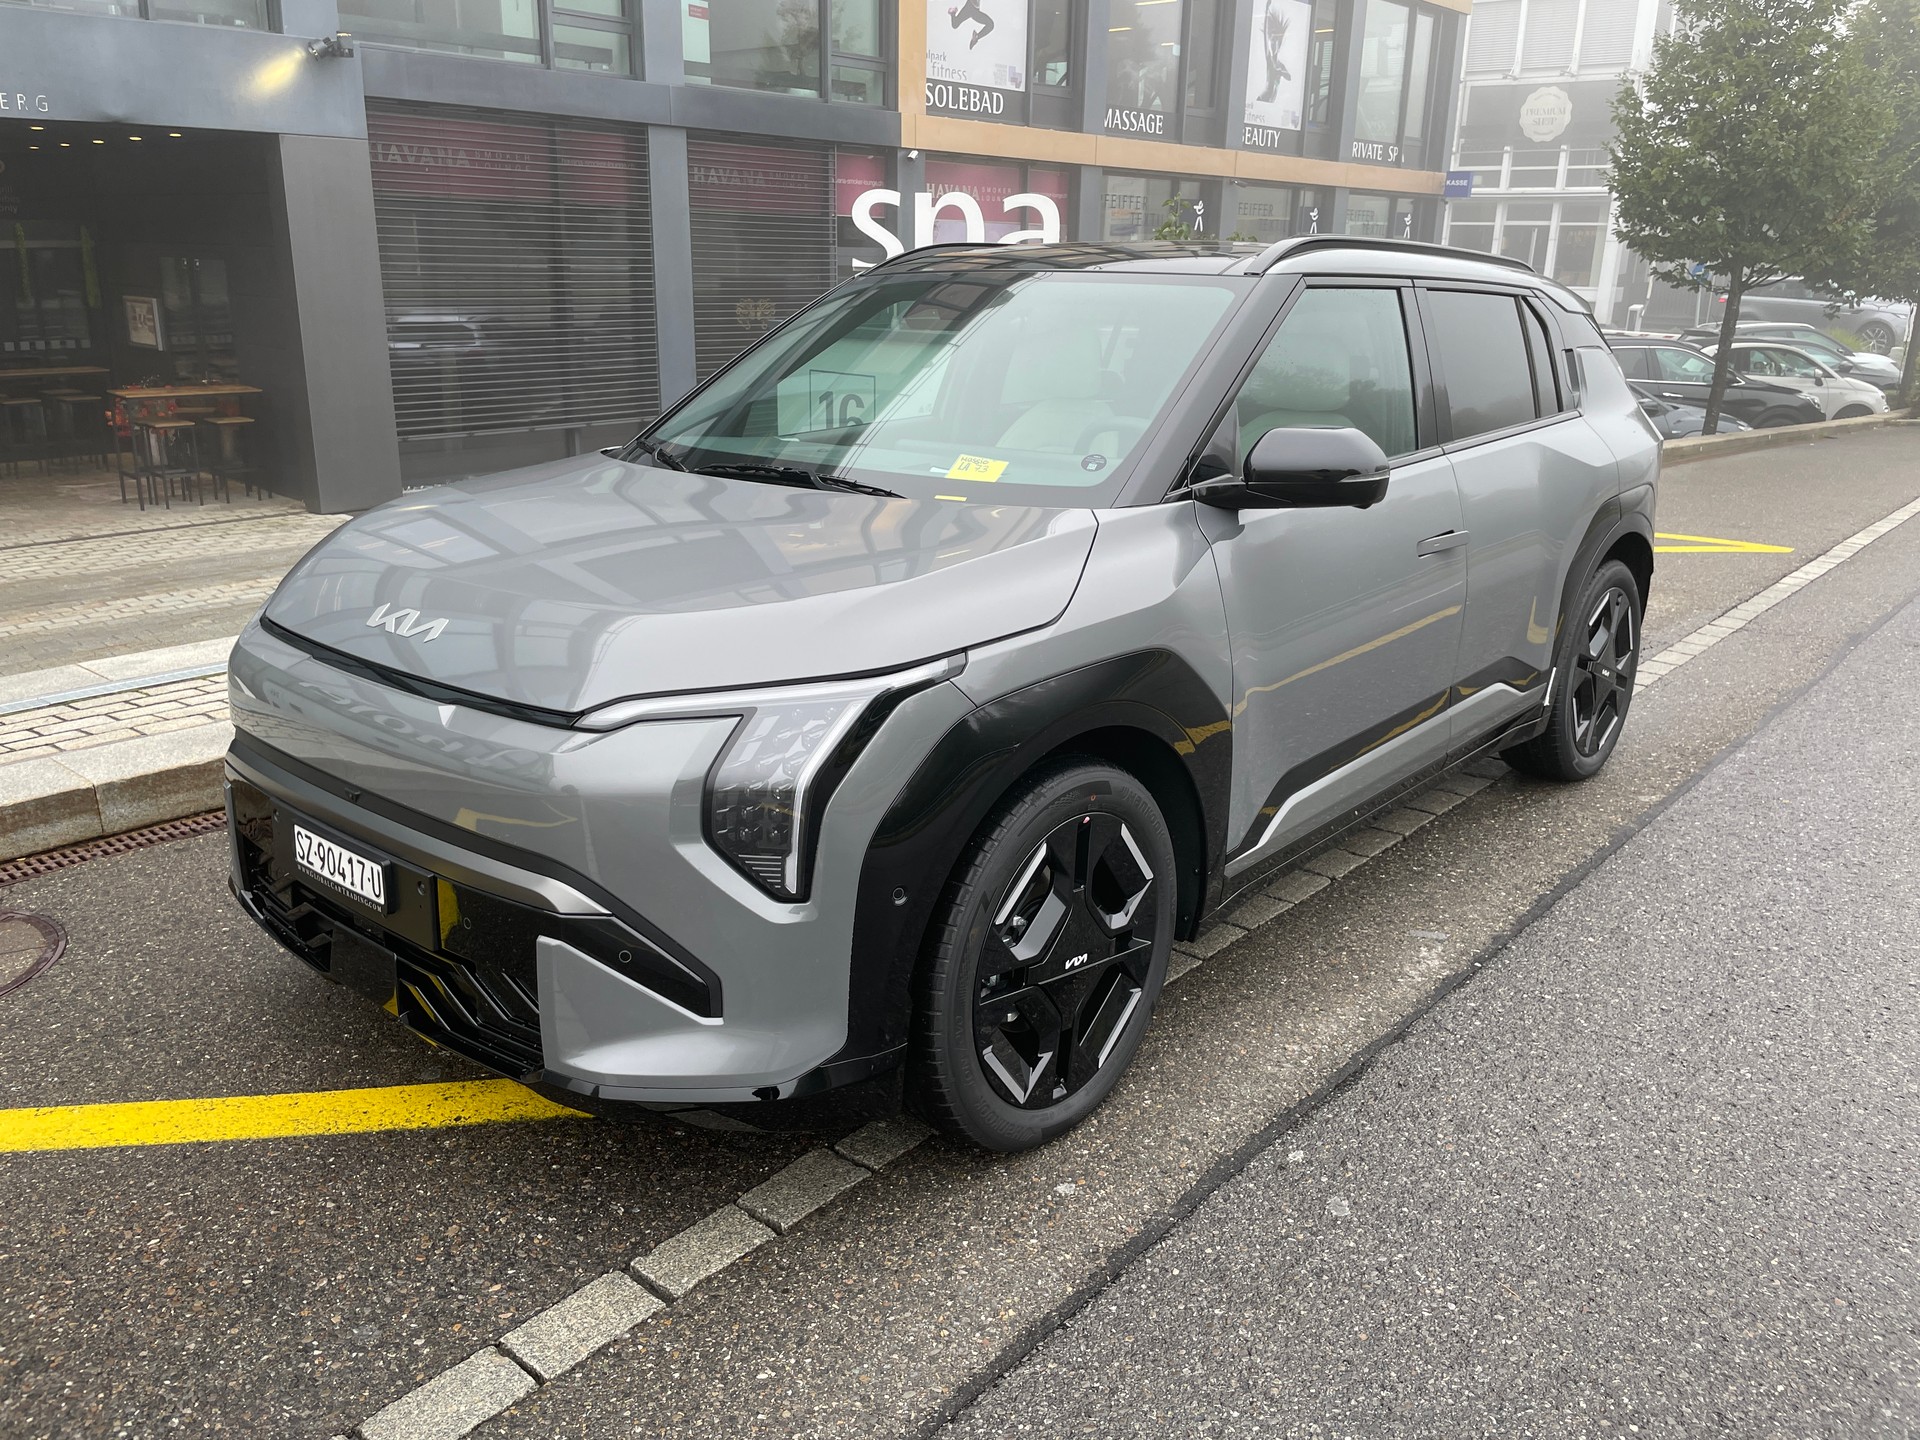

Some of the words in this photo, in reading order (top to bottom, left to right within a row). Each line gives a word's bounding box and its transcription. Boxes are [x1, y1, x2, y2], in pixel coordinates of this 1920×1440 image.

[926, 50, 947, 64] lpark
[932, 62, 968, 81] fitness
[926, 82, 1004, 114] SOLEBAD
[1242, 127, 1281, 148] EAUTY
[1352, 141, 1383, 160] RIVATE
[1446, 179, 1468, 187] KASSE
[1101, 193, 1149, 210] FEIFFER
[1238, 202, 1274, 217] FEIFFER
[818, 390, 865, 430] 16
[366, 602, 450, 643] KIA
